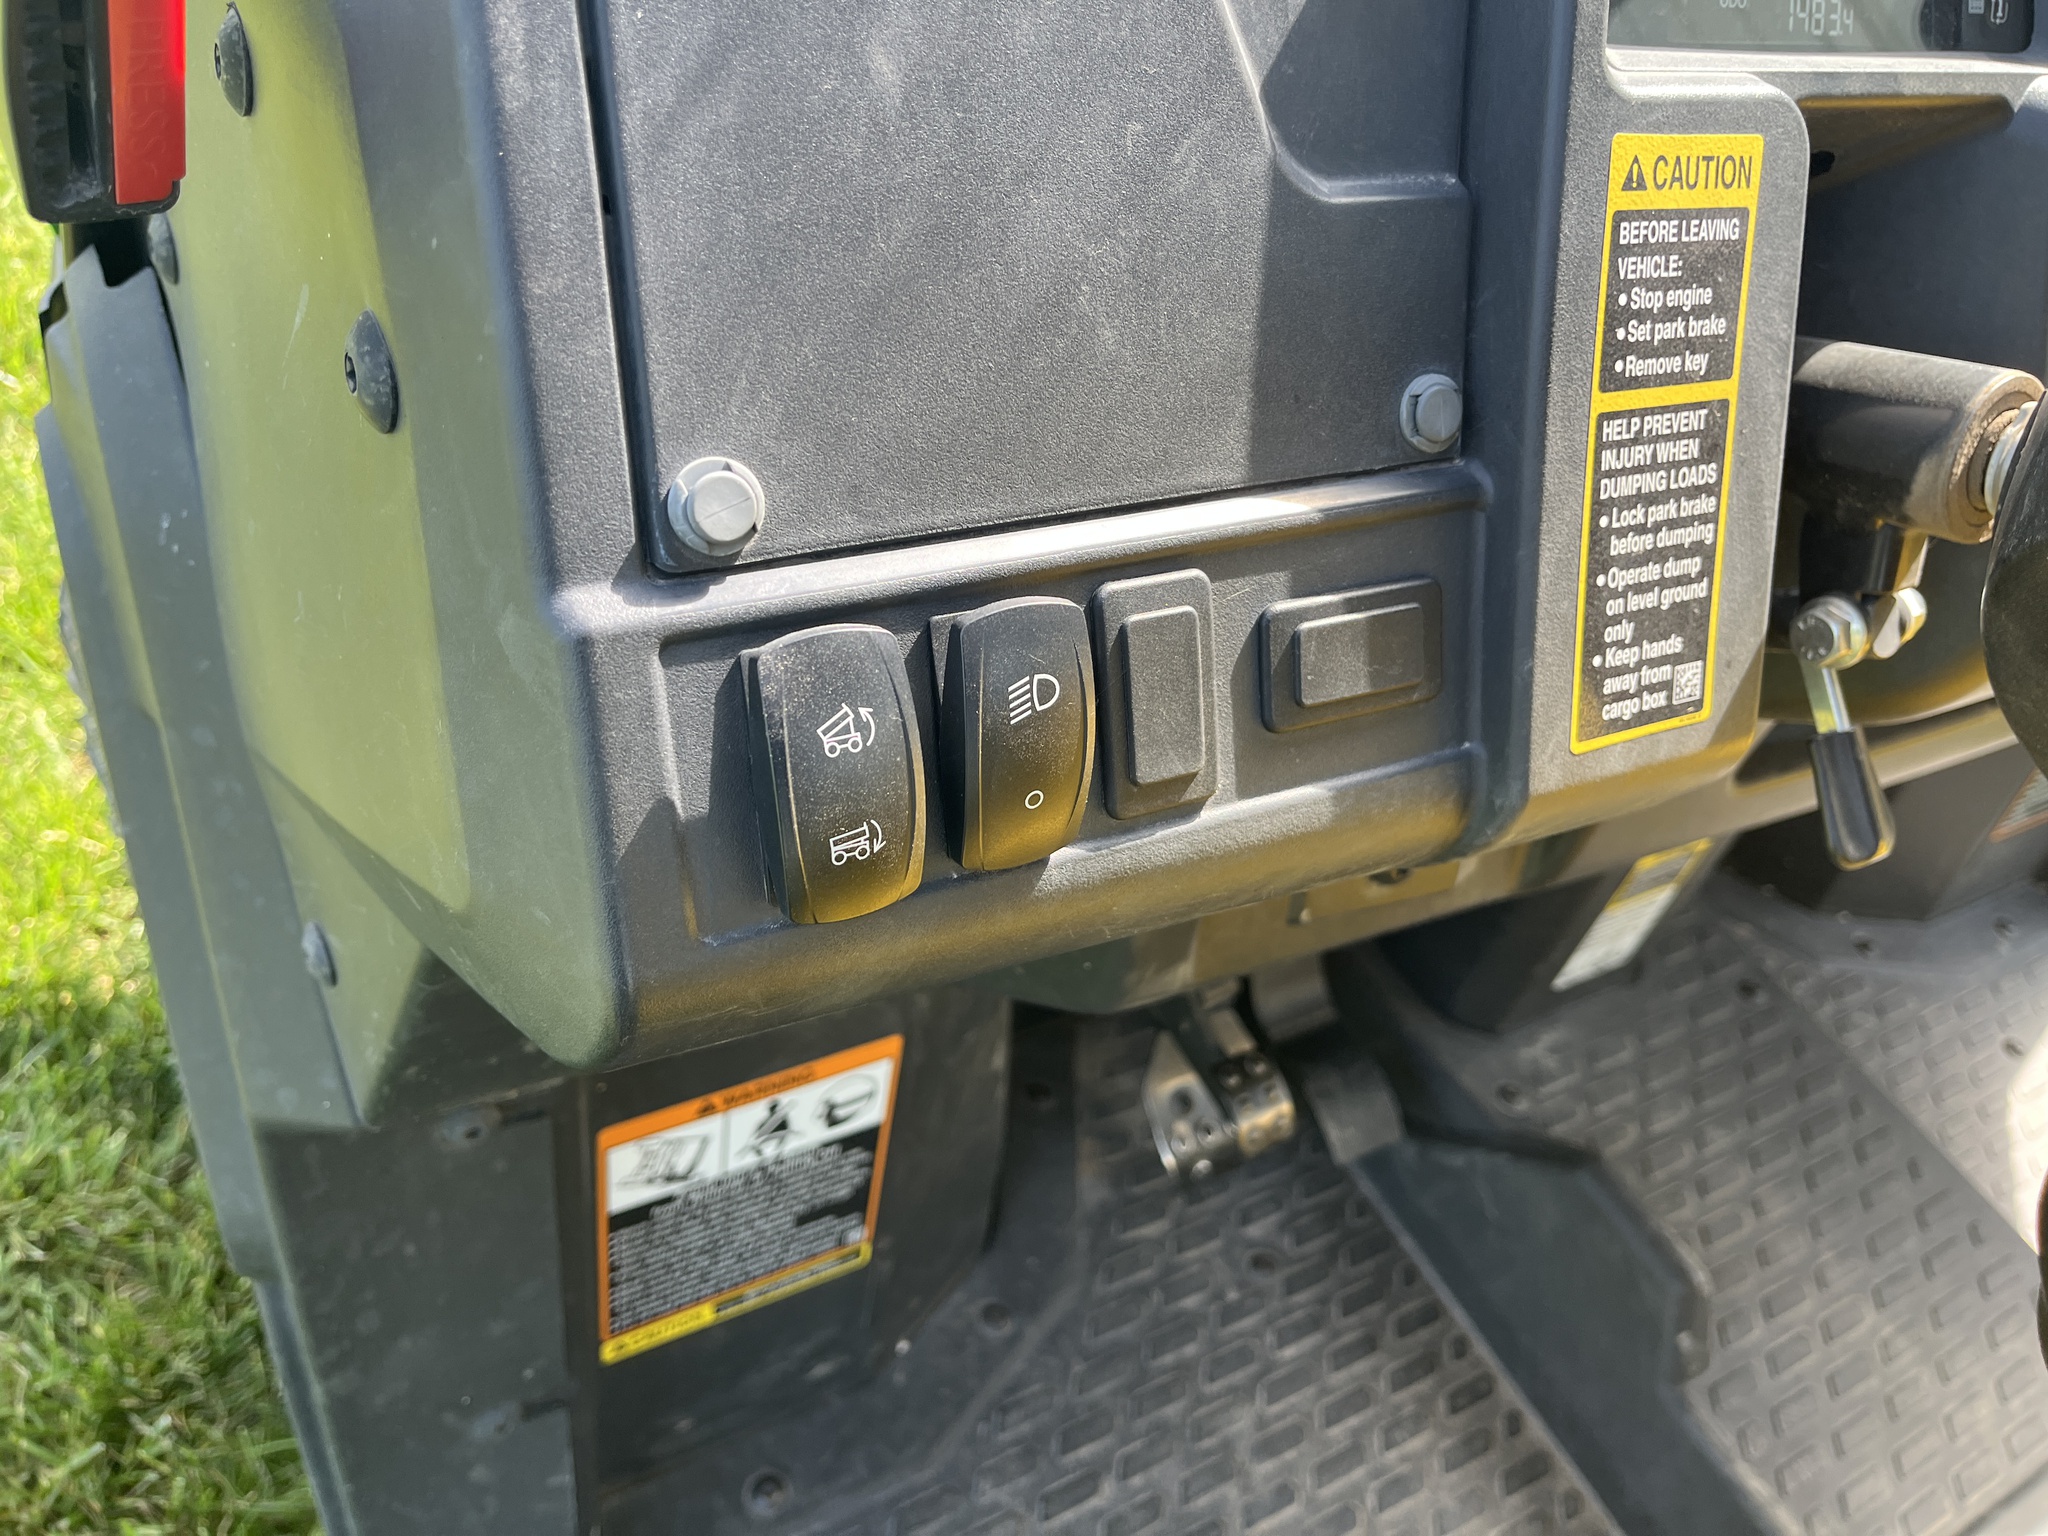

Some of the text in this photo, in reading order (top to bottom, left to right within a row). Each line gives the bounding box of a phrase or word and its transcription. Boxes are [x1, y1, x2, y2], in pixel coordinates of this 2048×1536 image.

[1653, 154, 1752, 191] CAUTION
[1619, 218, 1740, 245] BEFORE LEAVING
[1618, 255, 1683, 280] VEHICLE:
[1630, 284, 1713, 313] Stop engine
[1627, 314, 1727, 346] Set park brake
[1625, 350, 1710, 378] Remove key
[1602, 409, 1708, 442] HELP PREVENT
[1601, 438, 1700, 471] INJURY WHEN
[1599, 463, 1718, 500] DUMPING LOADS
[1611, 493, 1718, 528] Lock park brake
[1610, 521, 1715, 556] before dumping
[1607, 556, 1702, 592] Operate dump
[1605, 576, 1709, 616] on level ground
[1603, 619, 1635, 644] only
[1605, 633, 1684, 668] Keep hands
[1602, 664, 1673, 695] away from
[1602, 690, 1668, 720] cargo box
